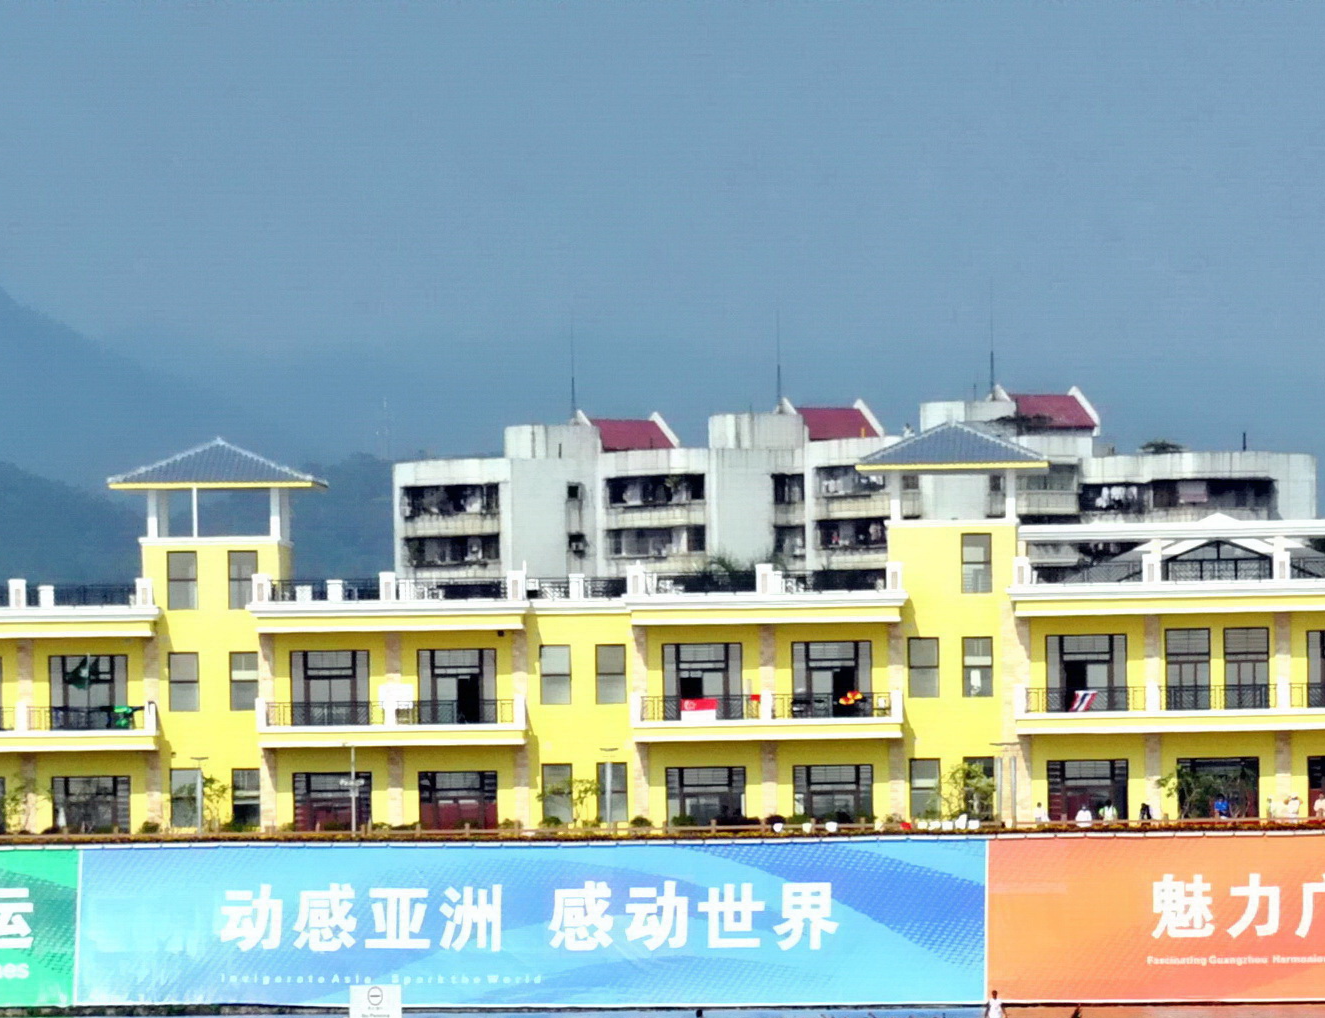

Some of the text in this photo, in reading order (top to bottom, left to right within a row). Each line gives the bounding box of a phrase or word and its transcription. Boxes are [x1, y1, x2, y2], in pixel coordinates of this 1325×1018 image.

[219, 881, 839, 953] 动感亚洲 感动世界
[1208, 955, 1268, 966] Guangzhou
